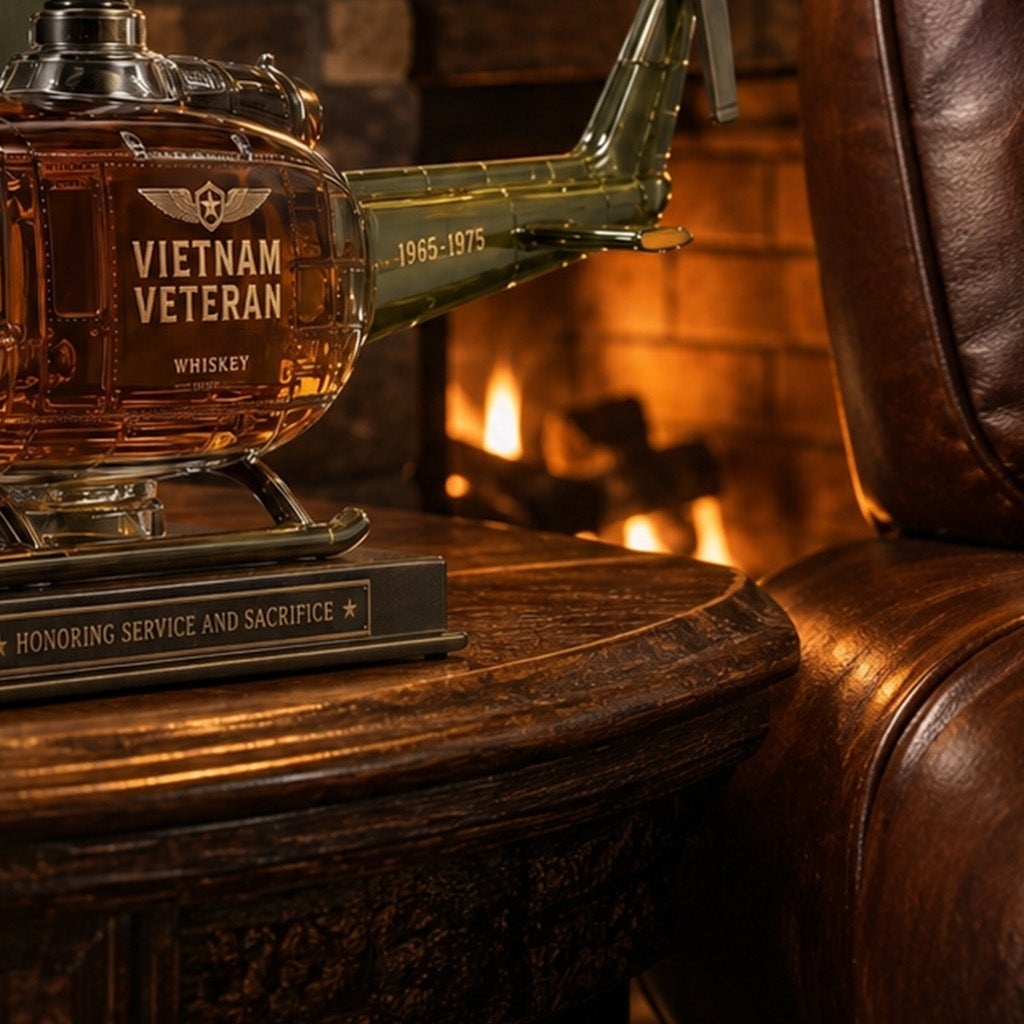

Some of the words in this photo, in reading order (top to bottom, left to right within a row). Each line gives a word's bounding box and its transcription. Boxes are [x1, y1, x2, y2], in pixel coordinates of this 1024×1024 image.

[132, 239, 282, 279] VIETNAM
[398, 227, 486, 268] 1965-1975
[134, 283, 282, 324] VETERAN
[174, 355, 251, 374] WHISKEY
[16, 623, 116, 656] HONORING
[120, 614, 197, 644] SERVICE
[202, 610, 240, 636] AND
[244, 601, 335, 631] SACRIFICE
